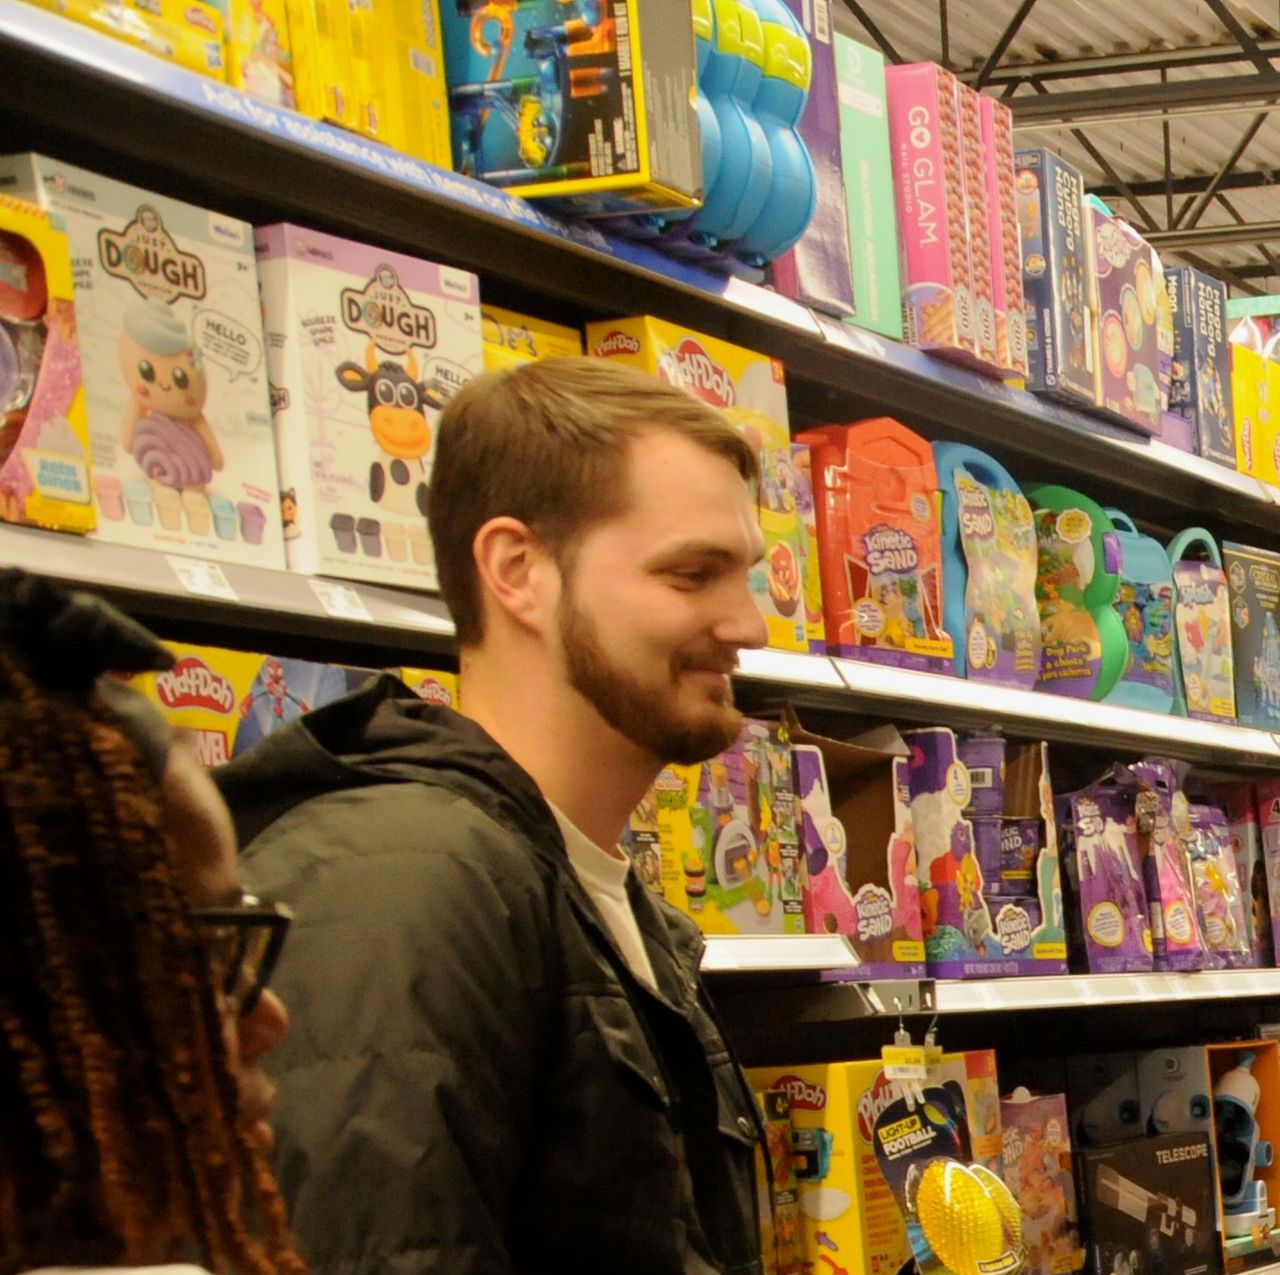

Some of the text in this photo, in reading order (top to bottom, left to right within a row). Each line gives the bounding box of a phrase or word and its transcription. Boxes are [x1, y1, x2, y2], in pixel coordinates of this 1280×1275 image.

[243, 97, 281, 128] for
[282, 116, 388, 169] assistance
[388, 155, 435, 187] with
[908, 105, 939, 246] GO GLAM
[902, 173, 912, 214] STUDIO
[1055, 166, 1066, 227] Hand
[1060, 170, 1075, 252] Cyborg
[1069, 176, 1080, 237] Mega
[134, 234, 167, 250] JUST
[104, 236, 200, 292] DOUGH
[373, 290, 402, 305] JUST
[959, 296, 970, 329] 200
[1197, 281, 1208, 337] Hand
[205, 318, 247, 346] HELLO
[348, 296, 431, 342] DOUGH
[980, 307, 992, 342] 200
[1204, 284, 1217, 357] Cyborg
[1212, 289, 1223, 343] Mega
[594, 332, 641, 356] Play-Doh
[1011, 318, 1022, 353] 200
[659, 348, 736, 409] Play-Doh
[865, 528, 915, 552] Kinetic
[157, 669, 236, 712] Play-Doh
[412, 680, 453, 705] Play-Doh
[857, 901, 892, 920] Kinetic
[999, 916, 1030, 936] Kinetic
[879, 1117, 919, 1141] LIGHT-UP
[882, 1125, 938, 1157] FOOTBALL
[1155, 1143, 1209, 1164] TELESCOPE
